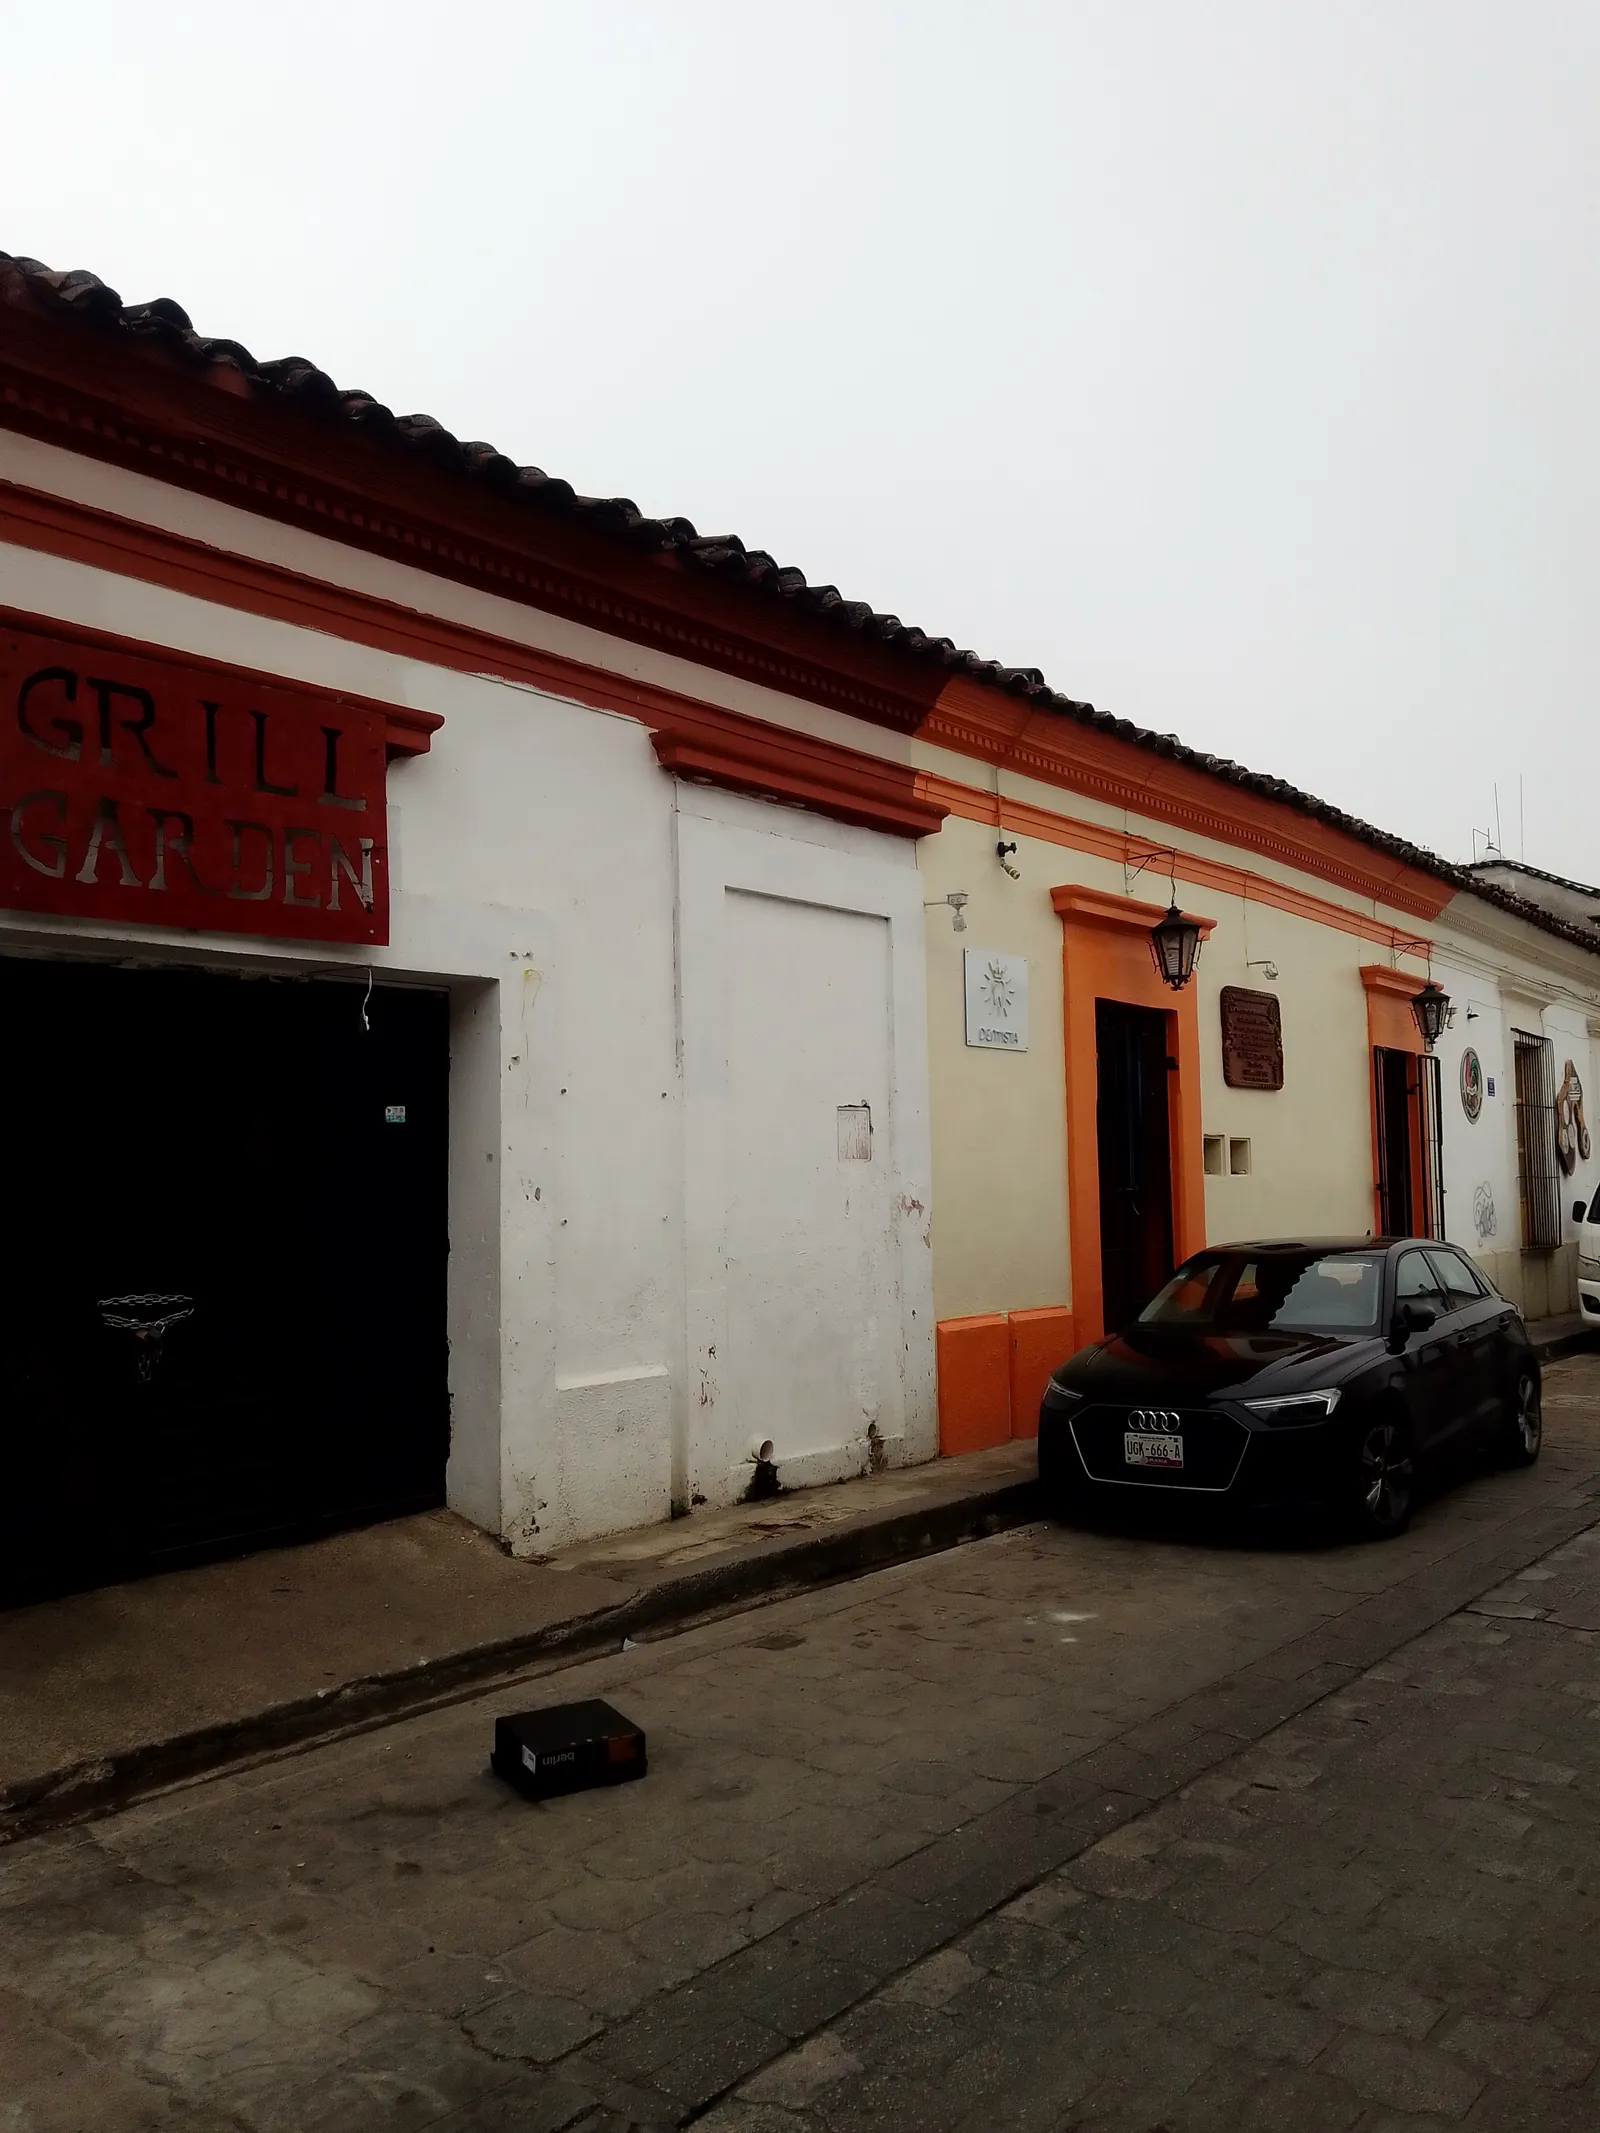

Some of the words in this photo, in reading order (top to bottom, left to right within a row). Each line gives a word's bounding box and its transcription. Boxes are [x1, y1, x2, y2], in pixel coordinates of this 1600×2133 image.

[17, 666, 367, 812] GRILL
[11, 790, 375, 914] GARDEN
[1126, 1441, 1181, 1459] UGK-666-A
[542, 1751, 575, 1767] berlin
